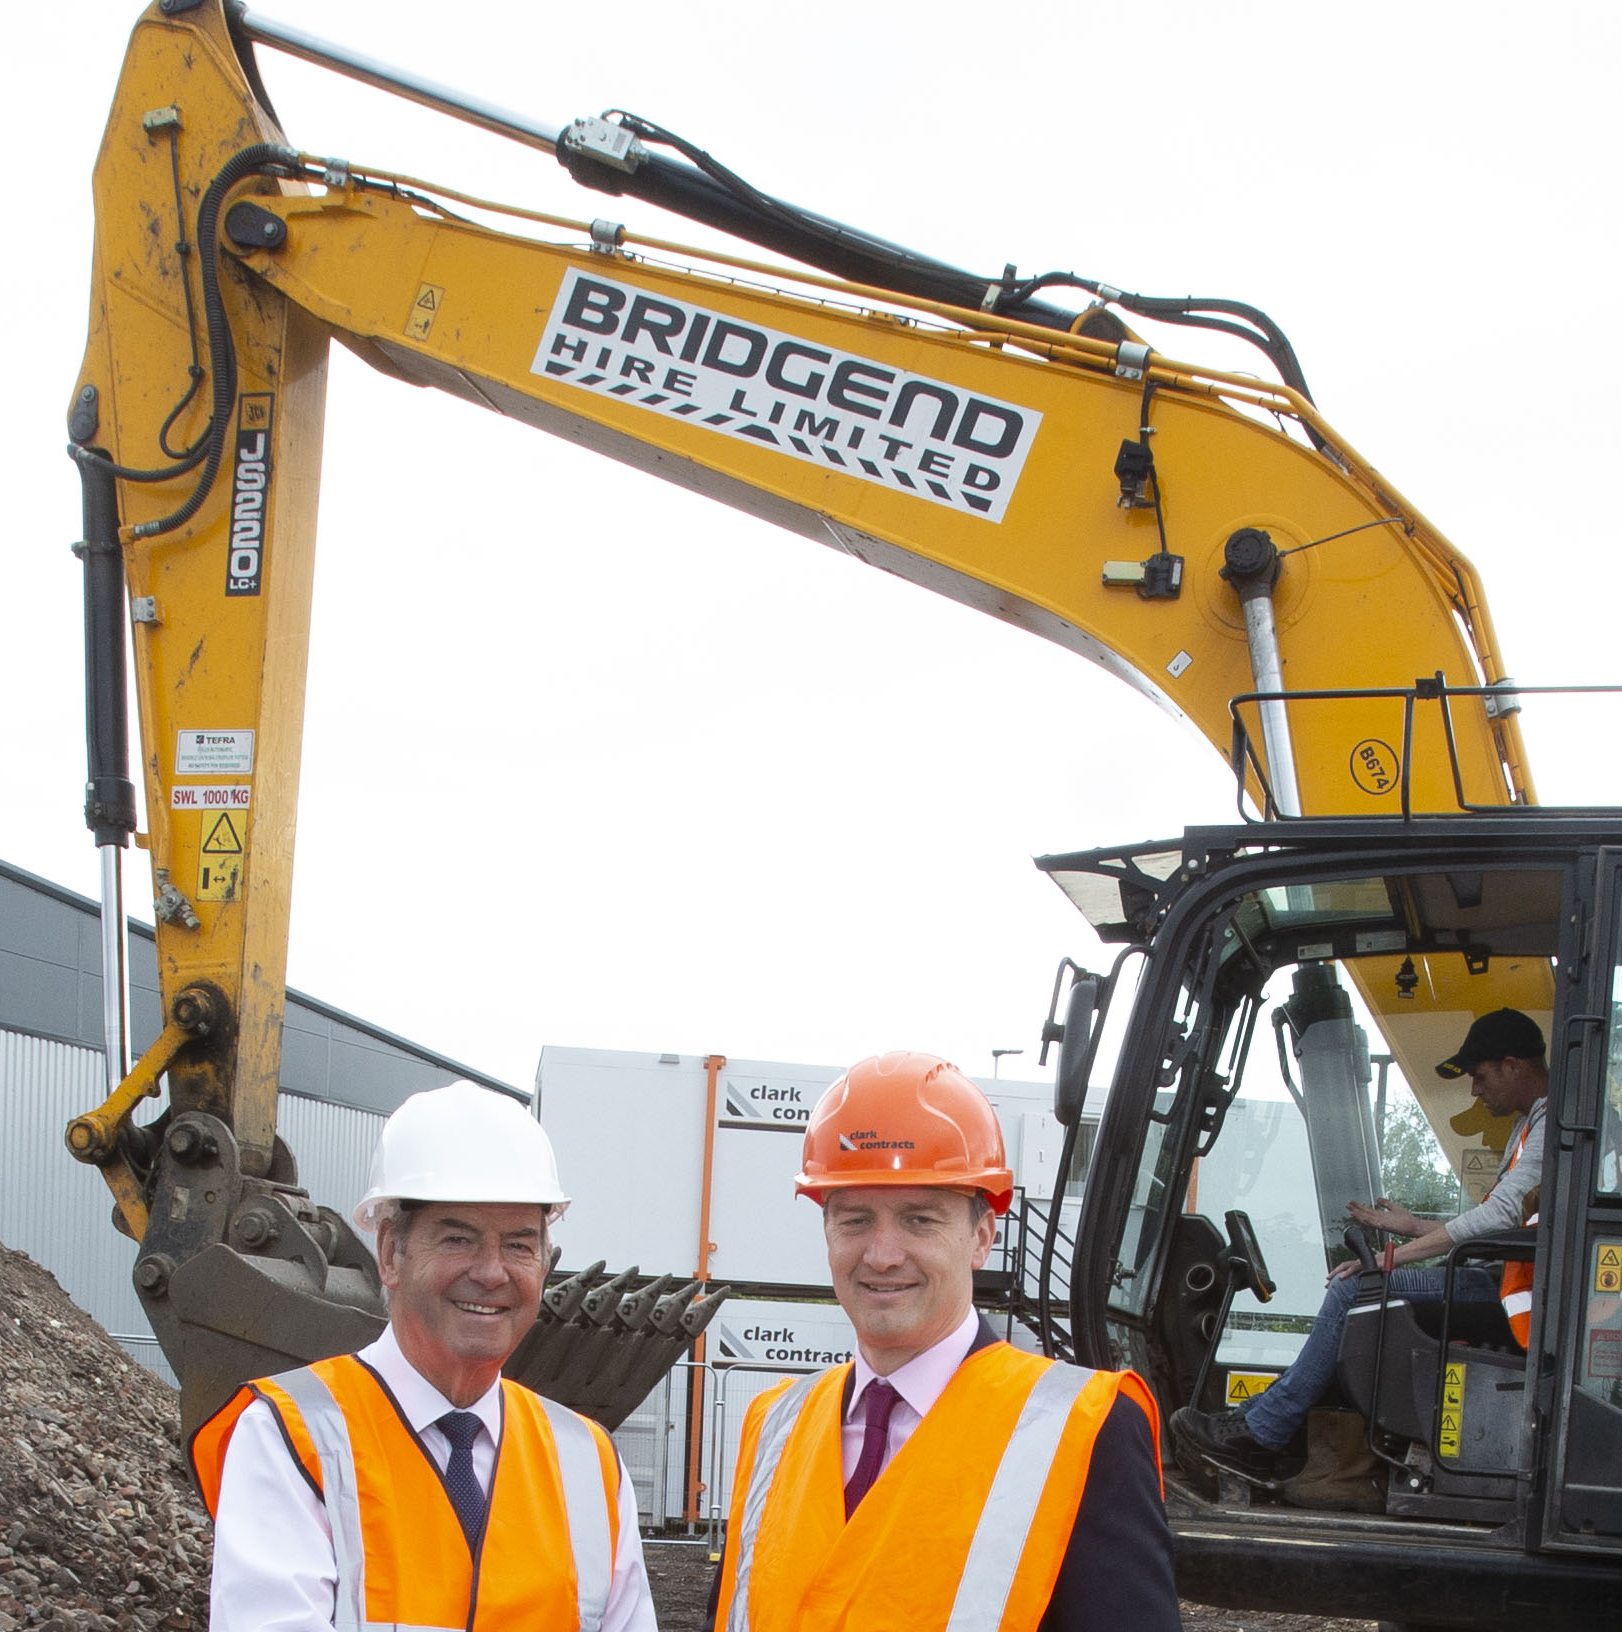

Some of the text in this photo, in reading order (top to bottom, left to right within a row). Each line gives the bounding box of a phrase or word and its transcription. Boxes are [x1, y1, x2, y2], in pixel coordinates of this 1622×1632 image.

[562, 276, 1024, 459] BRIDGEND
[550, 333, 1002, 492] HIRE LIMITED
[229, 432, 266, 578] JS220
[206, 736, 235, 745] TEFRA
[1359, 746, 1390, 789] B674
[173, 789, 249, 805] SWL 1000 KG
[750, 1084, 802, 1103] clark
[772, 1106, 813, 1121] con
[849, 1130, 877, 1141] clark
[859, 1140, 915, 1150] contracts
[743, 1326, 794, 1344] clark
[765, 1347, 855, 1364] contract
